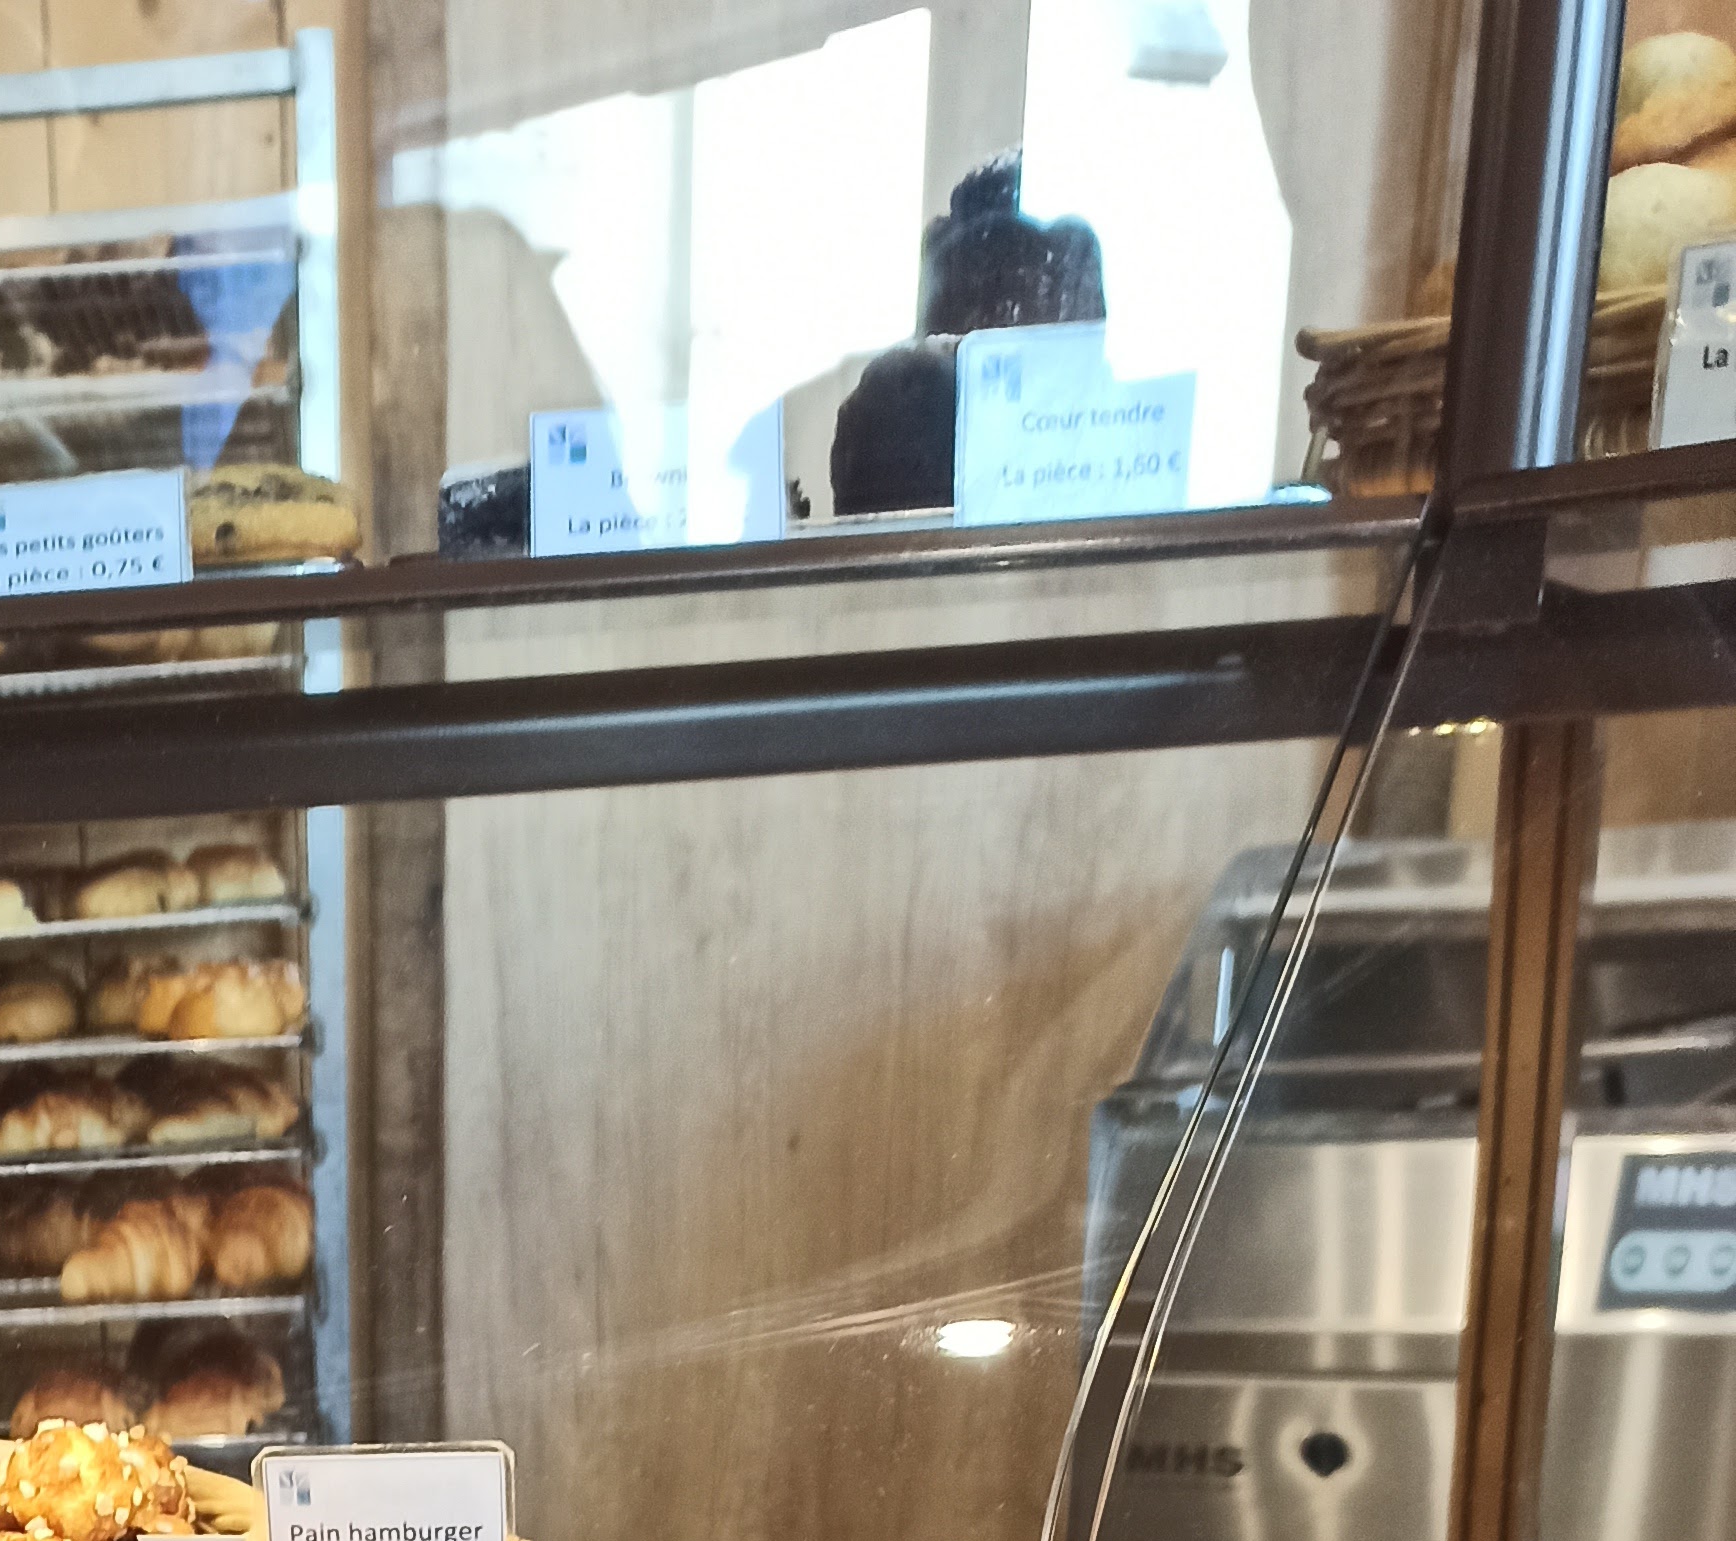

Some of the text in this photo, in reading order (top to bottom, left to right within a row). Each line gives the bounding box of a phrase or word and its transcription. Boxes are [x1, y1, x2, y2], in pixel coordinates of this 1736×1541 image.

[1702, 345, 1729, 370] La
[1090, 400, 1165, 426] tendre
[1002, 463, 1025, 487] La
[1032, 458, 1091, 489] pièce
[1167, 450, 1182, 473] €
[568, 516, 591, 534] La
[15, 534, 75, 559] petits
[82, 526, 164, 552] goûters
[8, 566, 69, 591] pièce
[92, 557, 143, 580] 0,75
[152, 554, 164, 571] €
[1126, 1443, 1244, 1478] MHS
